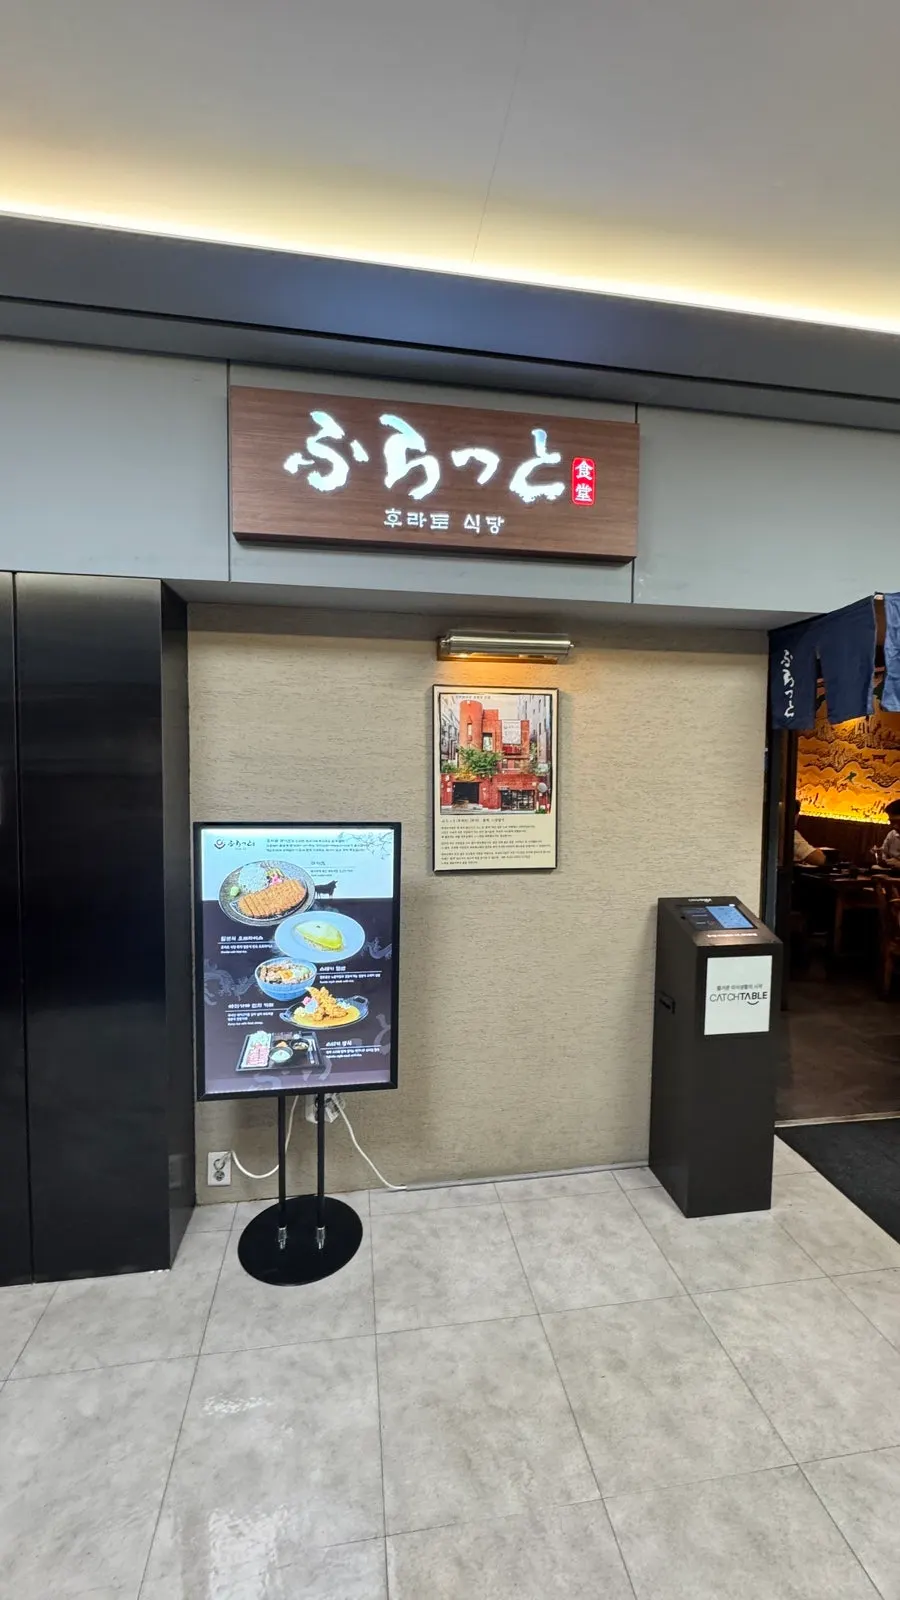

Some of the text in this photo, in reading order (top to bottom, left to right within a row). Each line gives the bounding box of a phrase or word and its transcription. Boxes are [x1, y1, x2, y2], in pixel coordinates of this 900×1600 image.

[283, 410, 566, 504] ふらっと
[573, 459, 593, 503] 食堂
[383, 508, 505, 535] 후라토 식당
[709, 991, 768, 1003] CATCHTABLE
